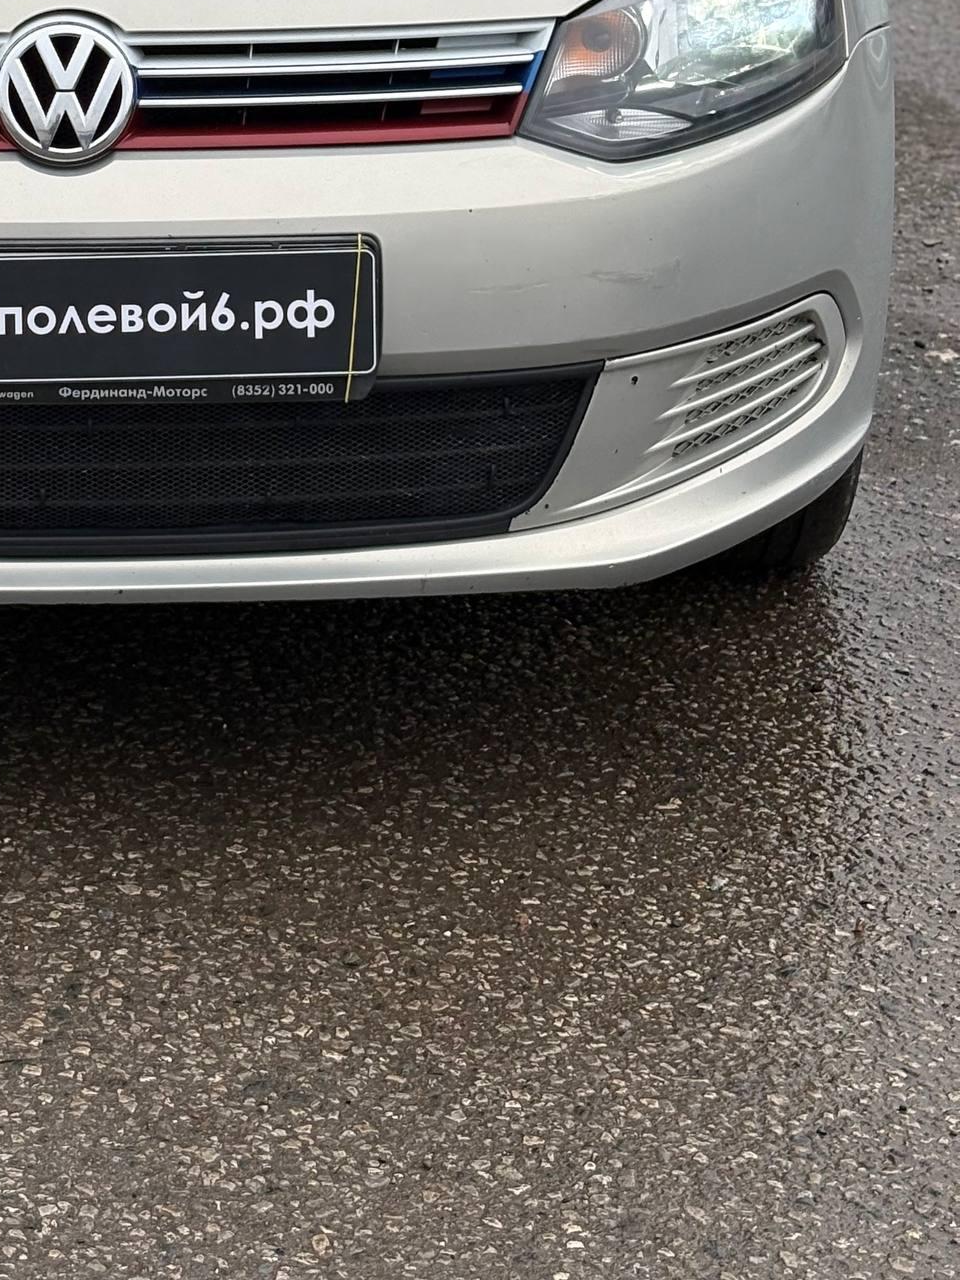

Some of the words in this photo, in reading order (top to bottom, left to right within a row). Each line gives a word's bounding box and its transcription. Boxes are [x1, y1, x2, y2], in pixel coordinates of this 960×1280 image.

[0, 24, 131, 160] VW
[58, 386, 208, 400] Фердинанд-Моторс
[231, 383, 276, 397] (8352)
[277, 382, 335, 396] 321-000
